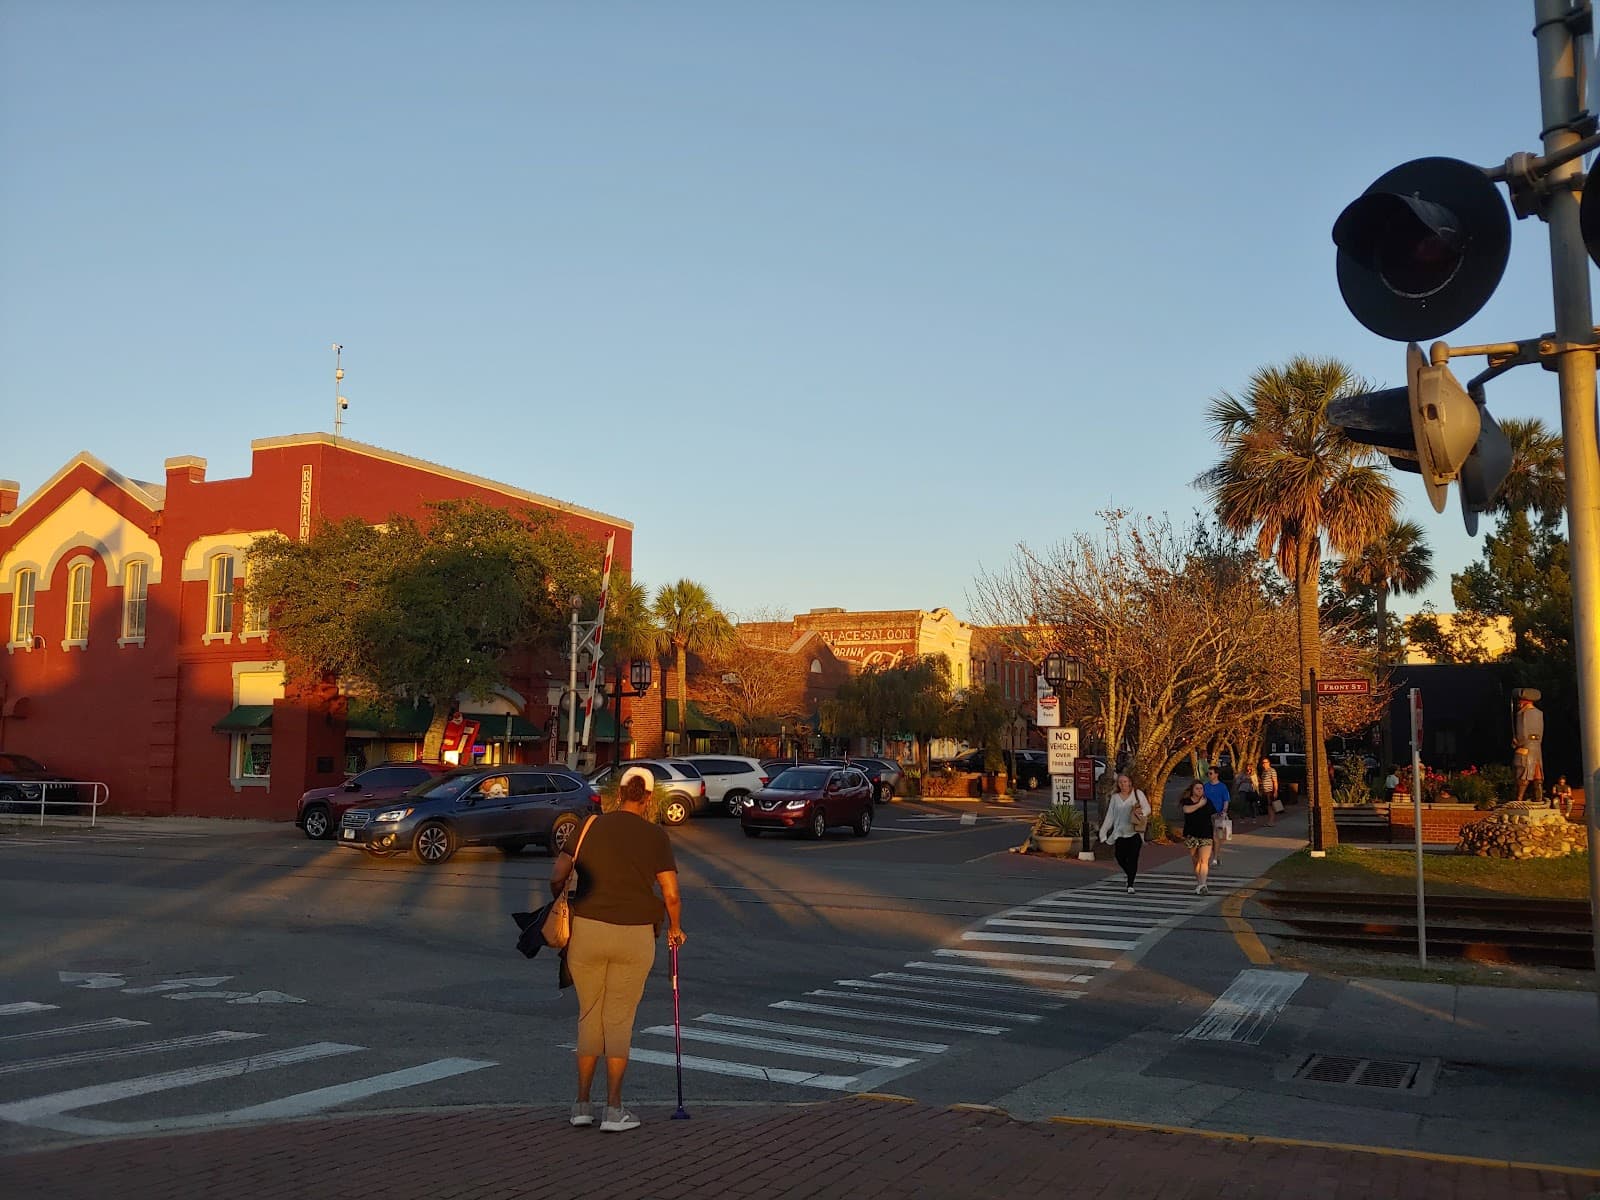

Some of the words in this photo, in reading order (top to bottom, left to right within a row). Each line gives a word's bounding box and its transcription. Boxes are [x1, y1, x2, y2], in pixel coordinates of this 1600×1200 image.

[821, 631, 861, 641] ALACE
[864, 630, 911, 640] SALOON
[834, 648, 865, 657] DRINK
[1055, 732, 1071, 741] NO
[1056, 792, 1071, 803] 15
